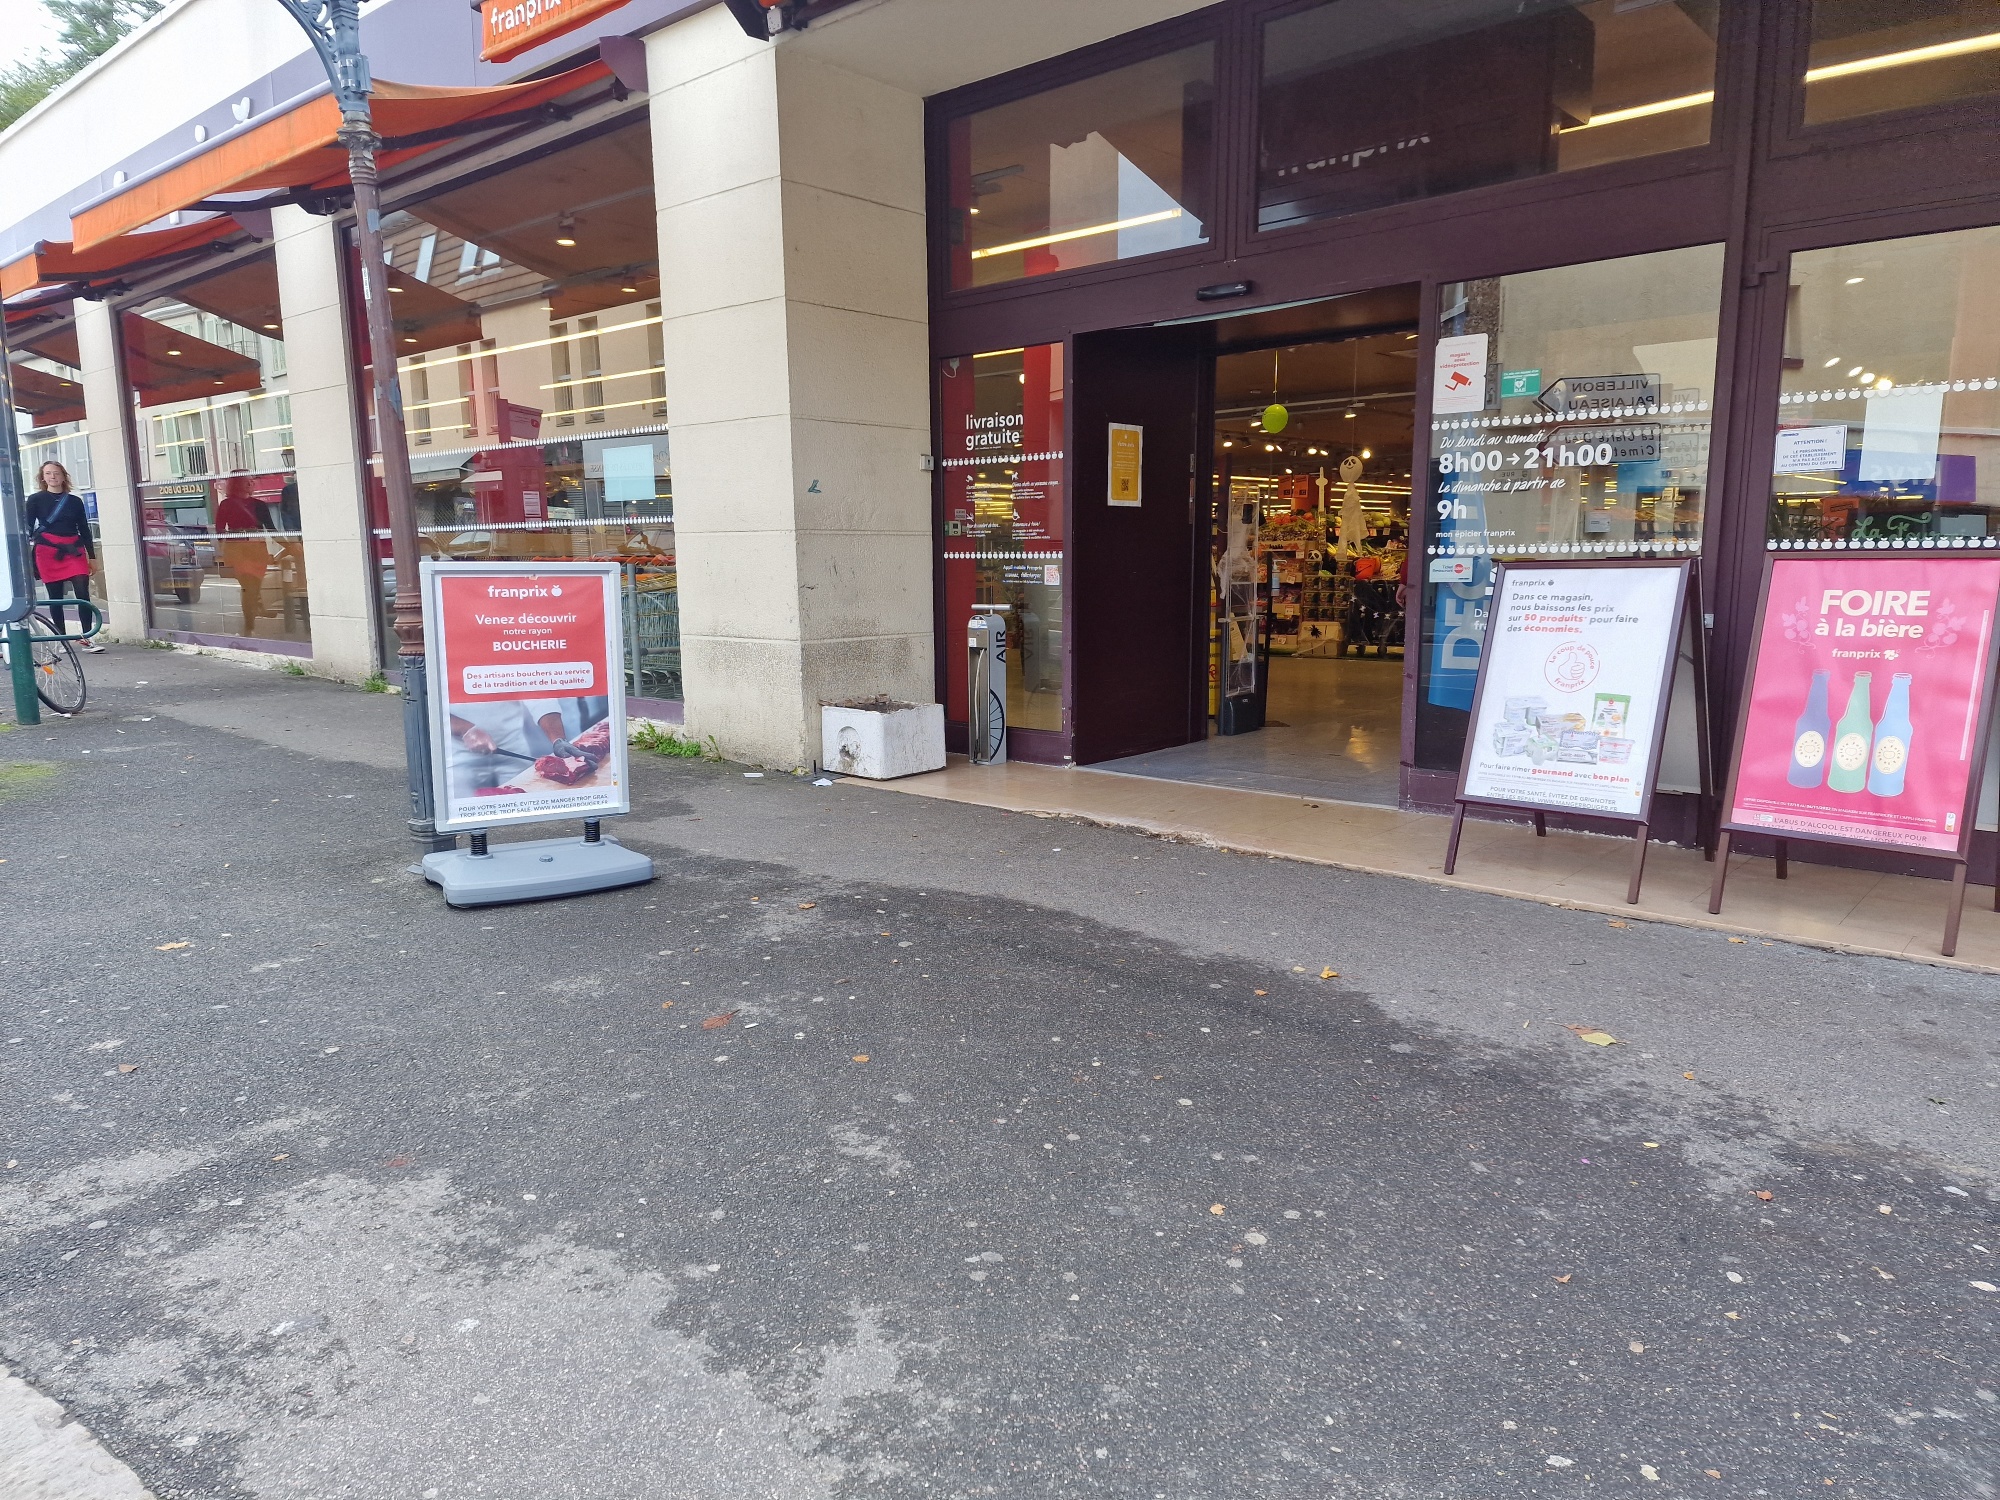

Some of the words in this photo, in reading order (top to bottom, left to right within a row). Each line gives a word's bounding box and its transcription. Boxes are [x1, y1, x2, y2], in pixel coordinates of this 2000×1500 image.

[966, 411, 1024, 430] livraison
[966, 428, 1020, 451] gratuite
[1440, 437, 1455, 449] Du
[1455, 434, 1485, 448] lundi
[1487, 436, 1503, 445] au
[1504, 429, 1546, 445] samedi
[1438, 450, 1503, 474] 8h00
[1524, 443, 1613, 469] 21h00
[1437, 481, 1451, 494] Le
[1451, 477, 1502, 494] dimanche
[1503, 478, 1512, 491] à
[1511, 476, 1549, 495] partir
[1550, 478, 1566, 489] de
[1437, 499, 1467, 520] 9h
[1455, 530, 1482, 539] épicier
[1483, 529, 1516, 538] franprix
[1512, 579, 1546, 587] franprix
[487, 585, 549, 600] franprix
[1512, 593, 1535, 601] Dans
[1550, 594, 1593, 603] magasin,
[1533, 603, 1576, 612] baissons
[1578, 604, 1592, 612] les
[1594, 604, 1615, 614] prix
[1820, 589, 1931, 617] FOIRE
[475, 614, 515, 625] Venez
[518, 612, 577, 625] découvrir
[1524, 613, 1537, 621] 50
[1589, 616, 1613, 625] pour
[1615, 615, 1639, 623] faire
[528, 628, 553, 636] rayon
[1523, 624, 1583, 634] économies.
[1815, 618, 1830, 636] à
[1835, 618, 1856, 637] la
[1861, 618, 1924, 639] bière
[493, 639, 567, 652] BOUCHERIE
[996, 630, 1006, 663] AIR
[1832, 648, 1881, 660] franprix
[466, 672, 482, 680] Des
[484, 671, 515, 679] artisans
[516, 669, 552, 678] bouchers
[493, 680, 527, 688] tradition
[550, 677, 558, 685] la
[1554, 677, 1585, 689] franprix
[1531, 768, 1574, 777] gourmand
[1580, 796, 1617, 805] GRIGNOTER
[1774, 817, 1799, 826] L'ABUS
[1800, 820, 1838, 831] D'ALCOOL
[1855, 827, 1903, 839] DANGEREUX
[1904, 833, 1927, 842] POUR
